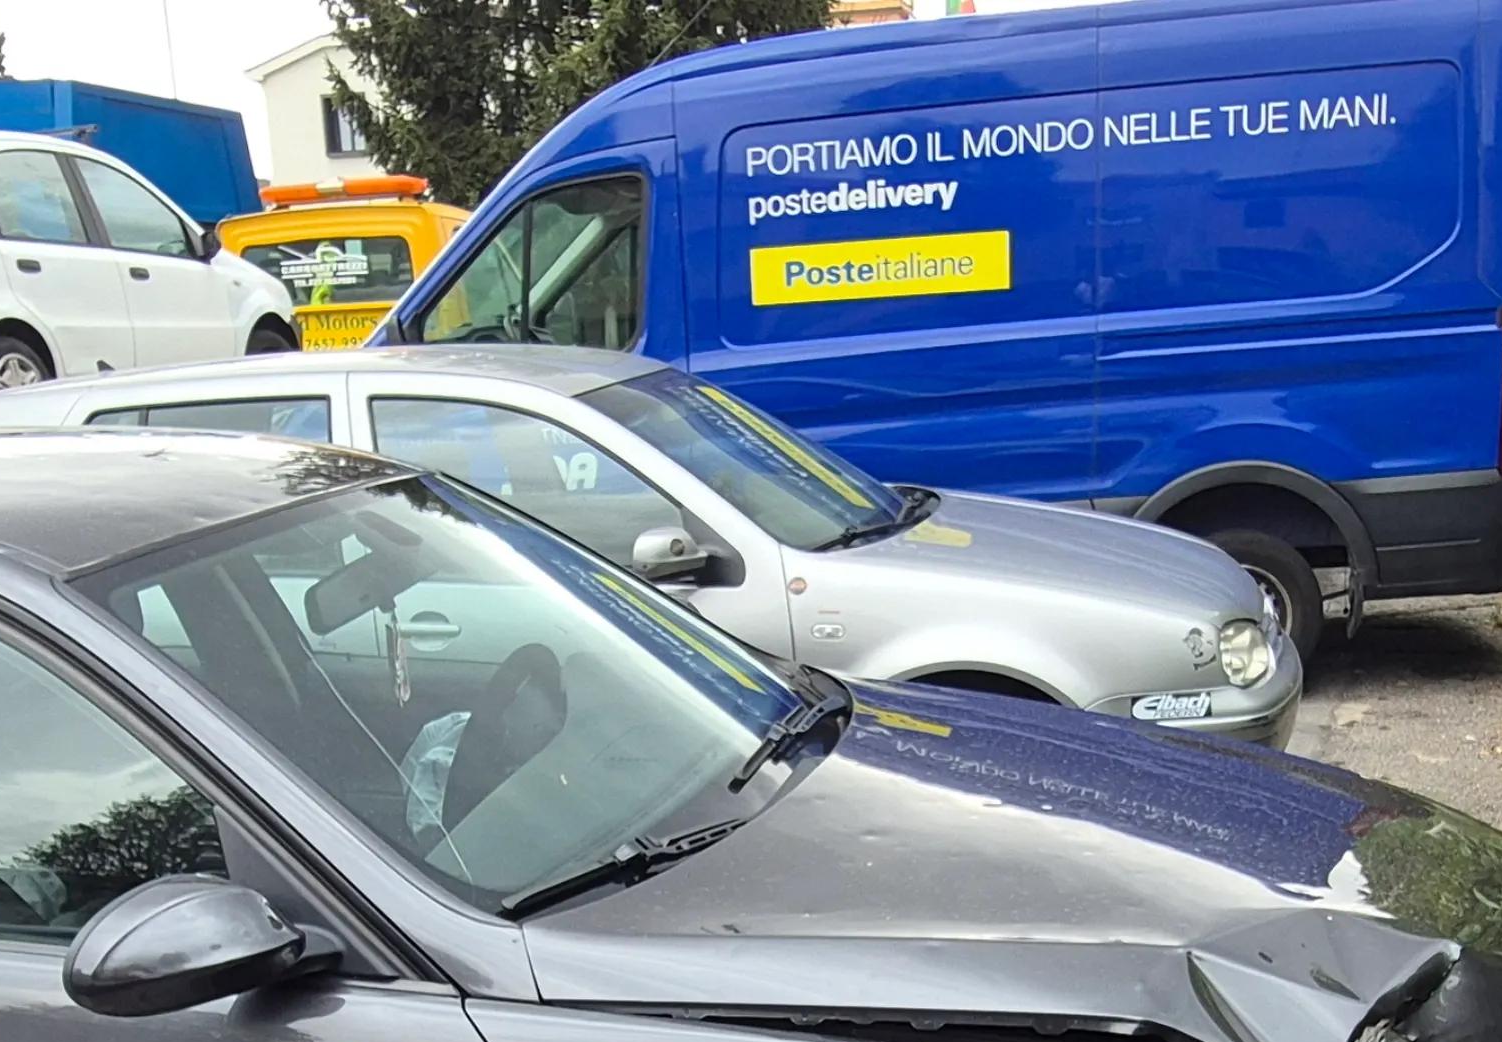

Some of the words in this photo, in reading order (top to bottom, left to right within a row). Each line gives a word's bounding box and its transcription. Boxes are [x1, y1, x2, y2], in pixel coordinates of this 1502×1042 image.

[747, 134, 917, 177] PORTIAMO
[927, 131, 955, 163] IL
[962, 119, 1094, 159] MONDO
[1104, 108, 1212, 148] NELLE
[1219, 101, 1290, 138] TUE
[1299, 93, 1397, 131] MANI.
[748, 179, 959, 226] postedelivery
